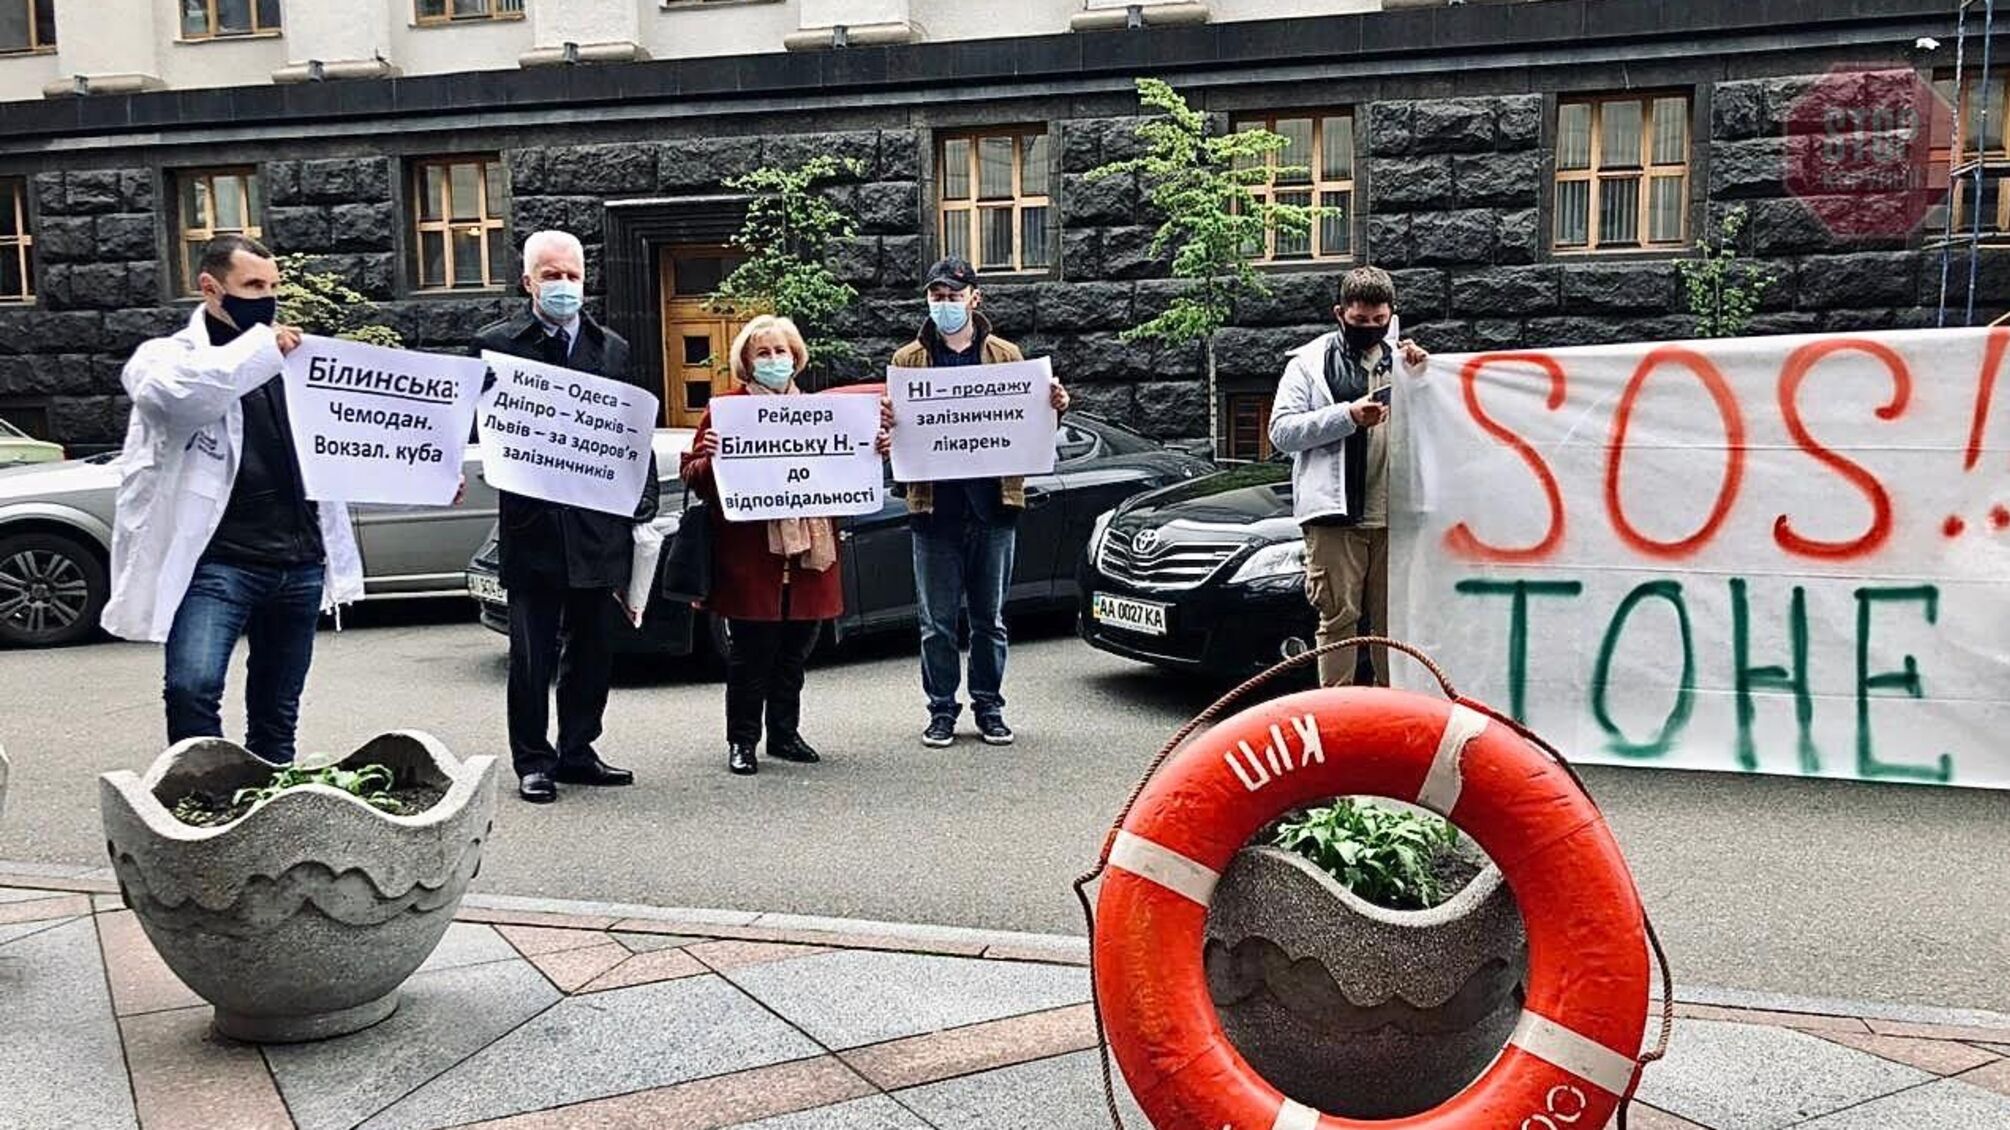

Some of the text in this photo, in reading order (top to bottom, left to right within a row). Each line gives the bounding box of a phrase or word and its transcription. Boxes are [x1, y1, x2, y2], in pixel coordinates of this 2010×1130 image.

[308, 356, 459, 399] Білинська:
[512, 369, 550, 392] Київ
[568, 383, 618, 408] Одеса
[907, 382, 932, 399] НІ
[952, 380, 1031, 397] продажу
[329, 401, 433, 431] Чемодан.
[493, 391, 556, 418] Дніпро
[574, 408, 624, 434] Харків
[757, 407, 834, 424] Рейдера
[916, 408, 1025, 426] залізничних
[484, 414, 530, 437] Львів
[548, 431, 567, 445] за
[314, 434, 443, 465] Вокзал. куба
[721, 435, 828, 455] Білинську
[833, 434, 854, 451] Н.
[933, 435, 1011, 452] лікарень
[502, 446, 615, 480] залізничників
[787, 467, 810, 483] до
[725, 487, 875, 510] відповідальності
[1118, 602, 1144, 624] 0027
[1455, 577, 1954, 783] ТОНЕ
